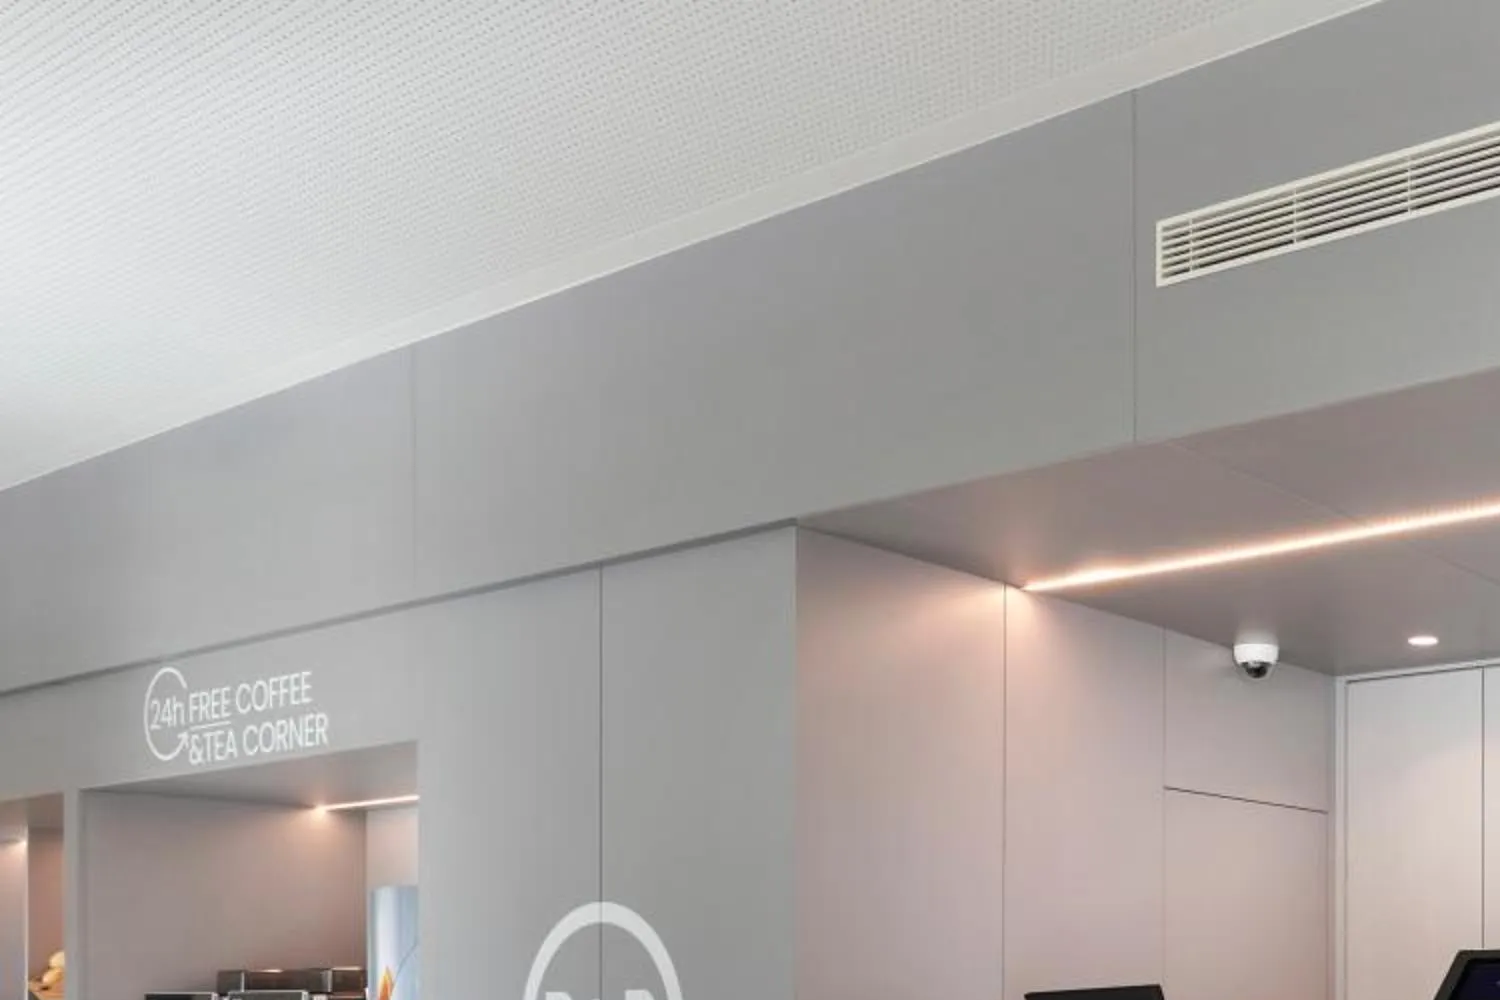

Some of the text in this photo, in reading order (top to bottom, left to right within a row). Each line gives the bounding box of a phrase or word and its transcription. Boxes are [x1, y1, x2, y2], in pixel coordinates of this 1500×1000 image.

[149, 670, 313, 731] 24h FREE COFFEE
[242, 712, 329, 756] CORNER
